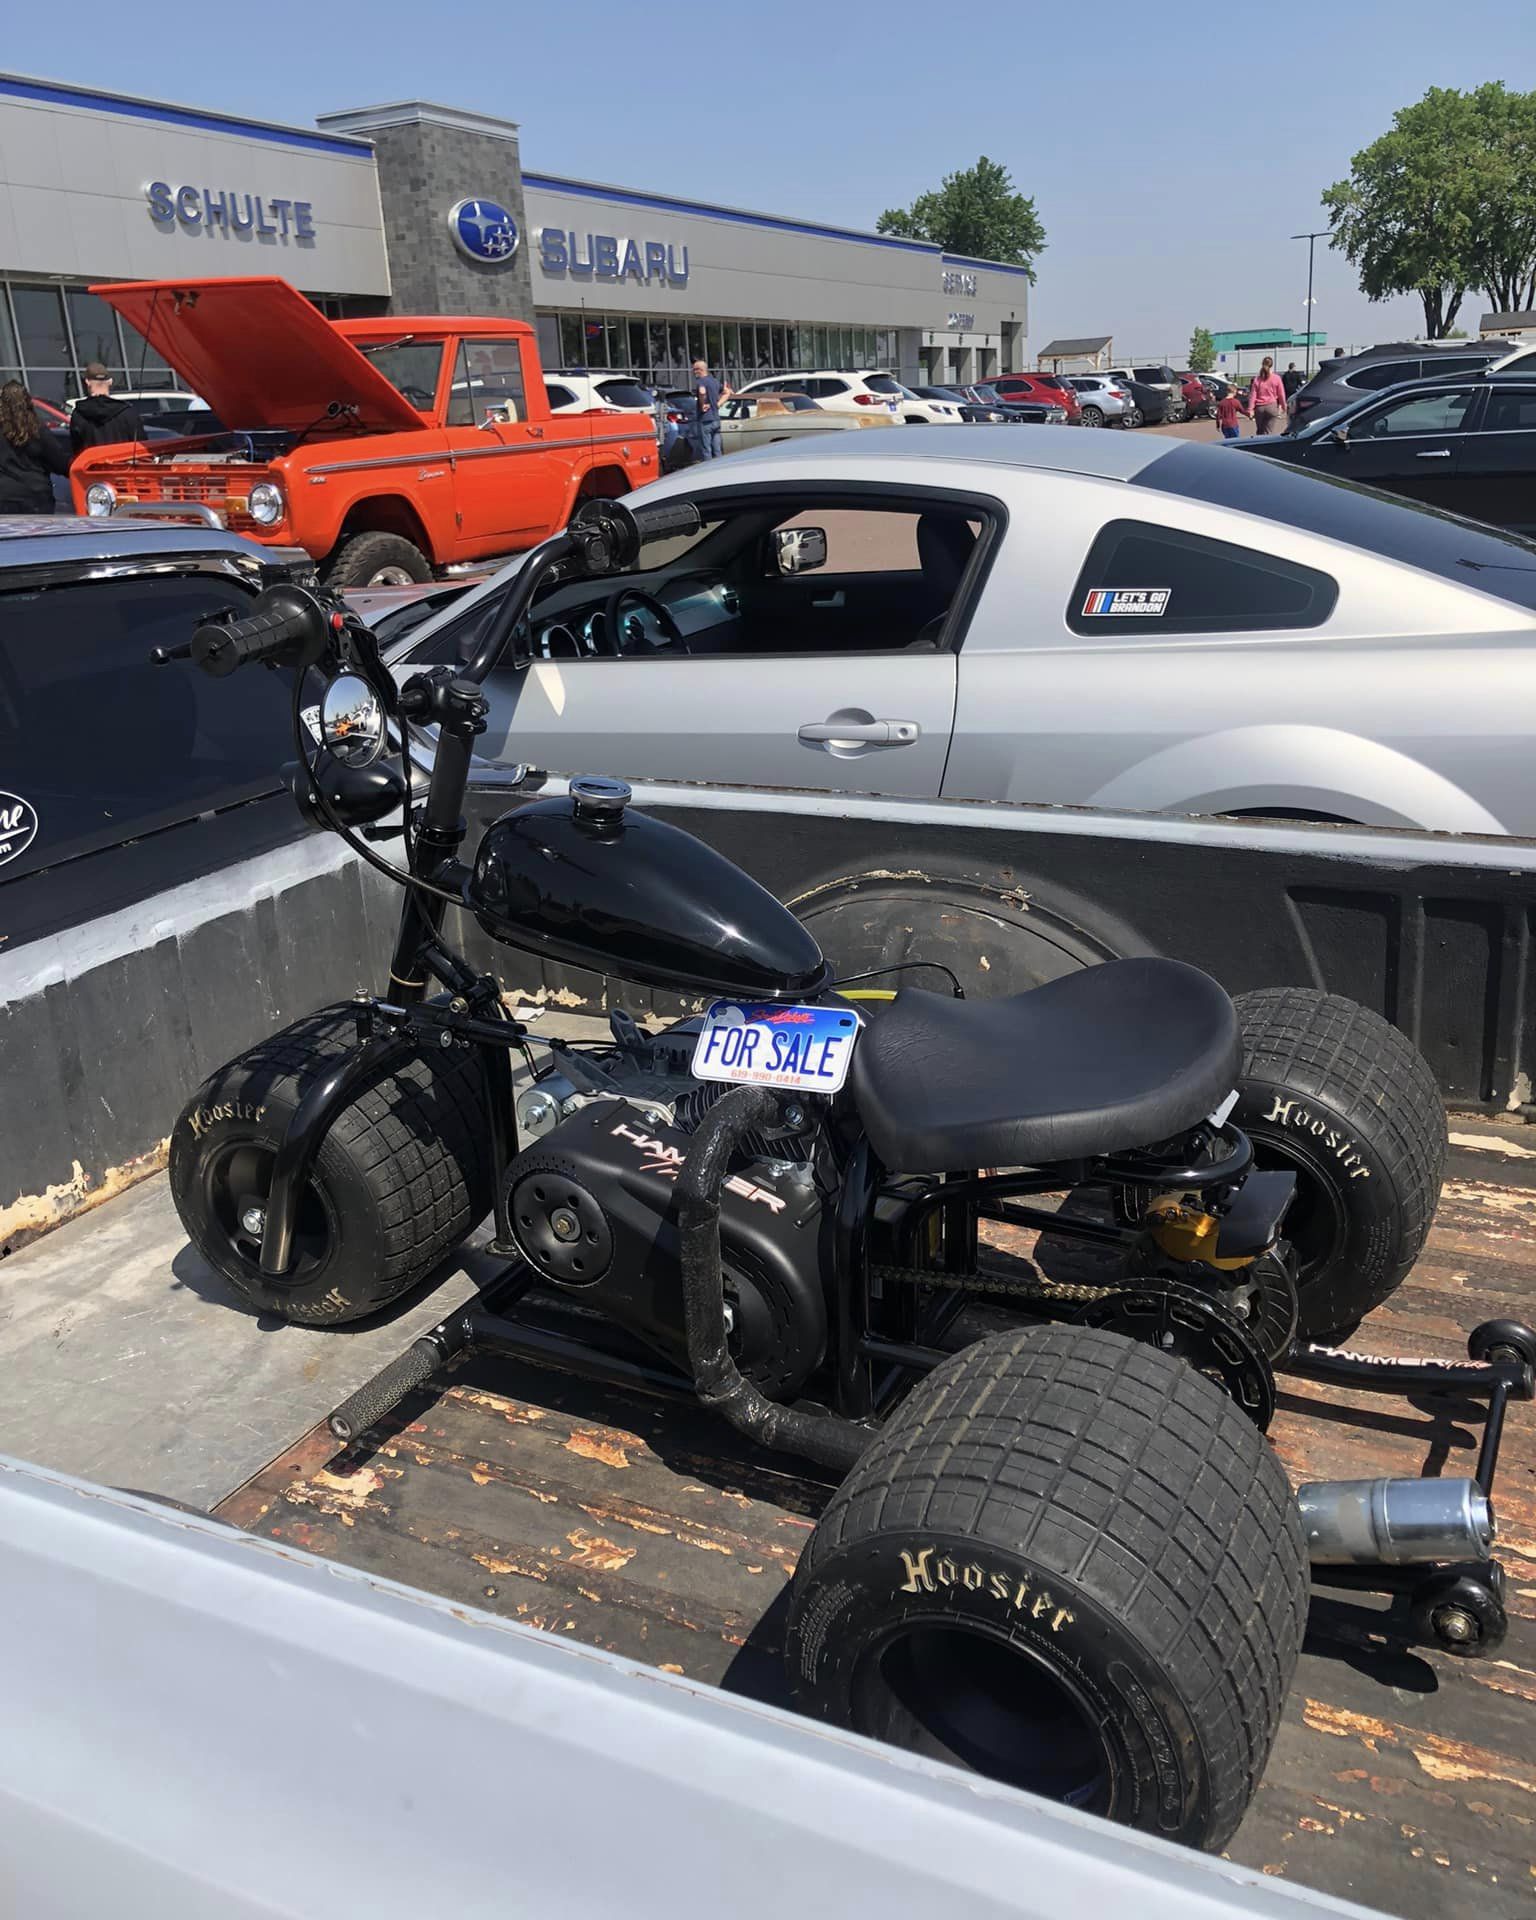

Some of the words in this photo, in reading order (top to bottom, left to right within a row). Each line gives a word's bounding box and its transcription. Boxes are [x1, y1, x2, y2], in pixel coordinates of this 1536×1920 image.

[147, 181, 317, 239] SCHULTE
[540, 227, 690, 284] SUBARU
[1110, 603, 1163, 613] BRANDON
[1113, 592, 1146, 603] LET'S
[1150, 592, 1166, 603] GO
[703, 1025, 761, 1068] FOR
[766, 1031, 842, 1077] SALE
[188, 1098, 266, 1141] Hoosier
[1261, 1095, 1371, 1180] Hoosier
[898, 1544, 1078, 1633] Hoosier
